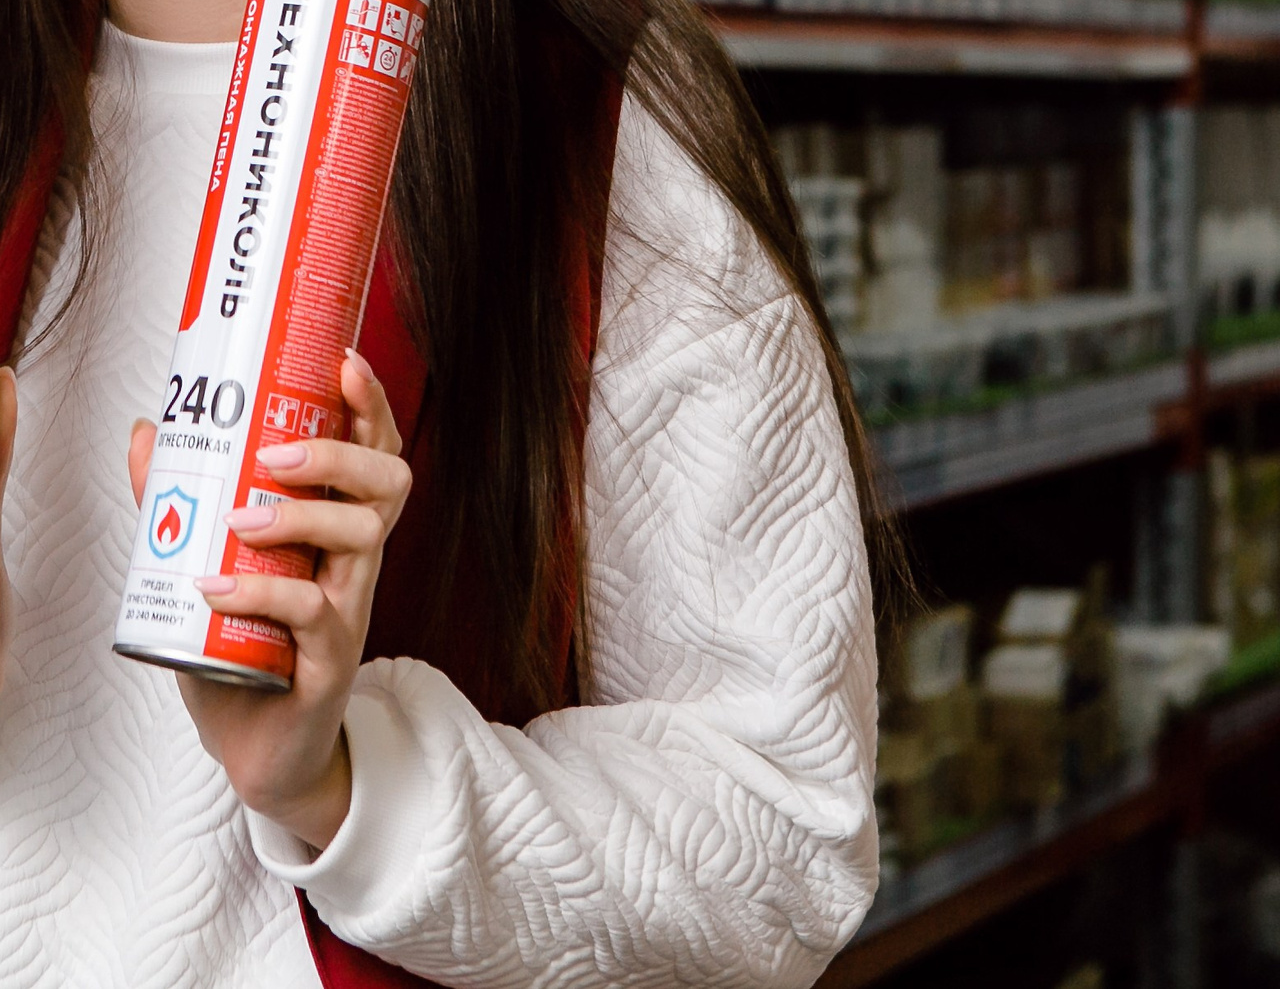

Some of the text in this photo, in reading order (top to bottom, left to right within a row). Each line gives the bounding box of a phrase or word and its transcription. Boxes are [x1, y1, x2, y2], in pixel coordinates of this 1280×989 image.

[210, 131, 230, 193] ПЕНА
[161, 374, 246, 430] 240
[158, 431, 232, 456] ОГНЕСТОЙКАЯ
[140, 578, 174, 592] ПРЕДЕЛ
[136, 610, 149, 622] 240
[150, 613, 185, 627] МИНУТ
